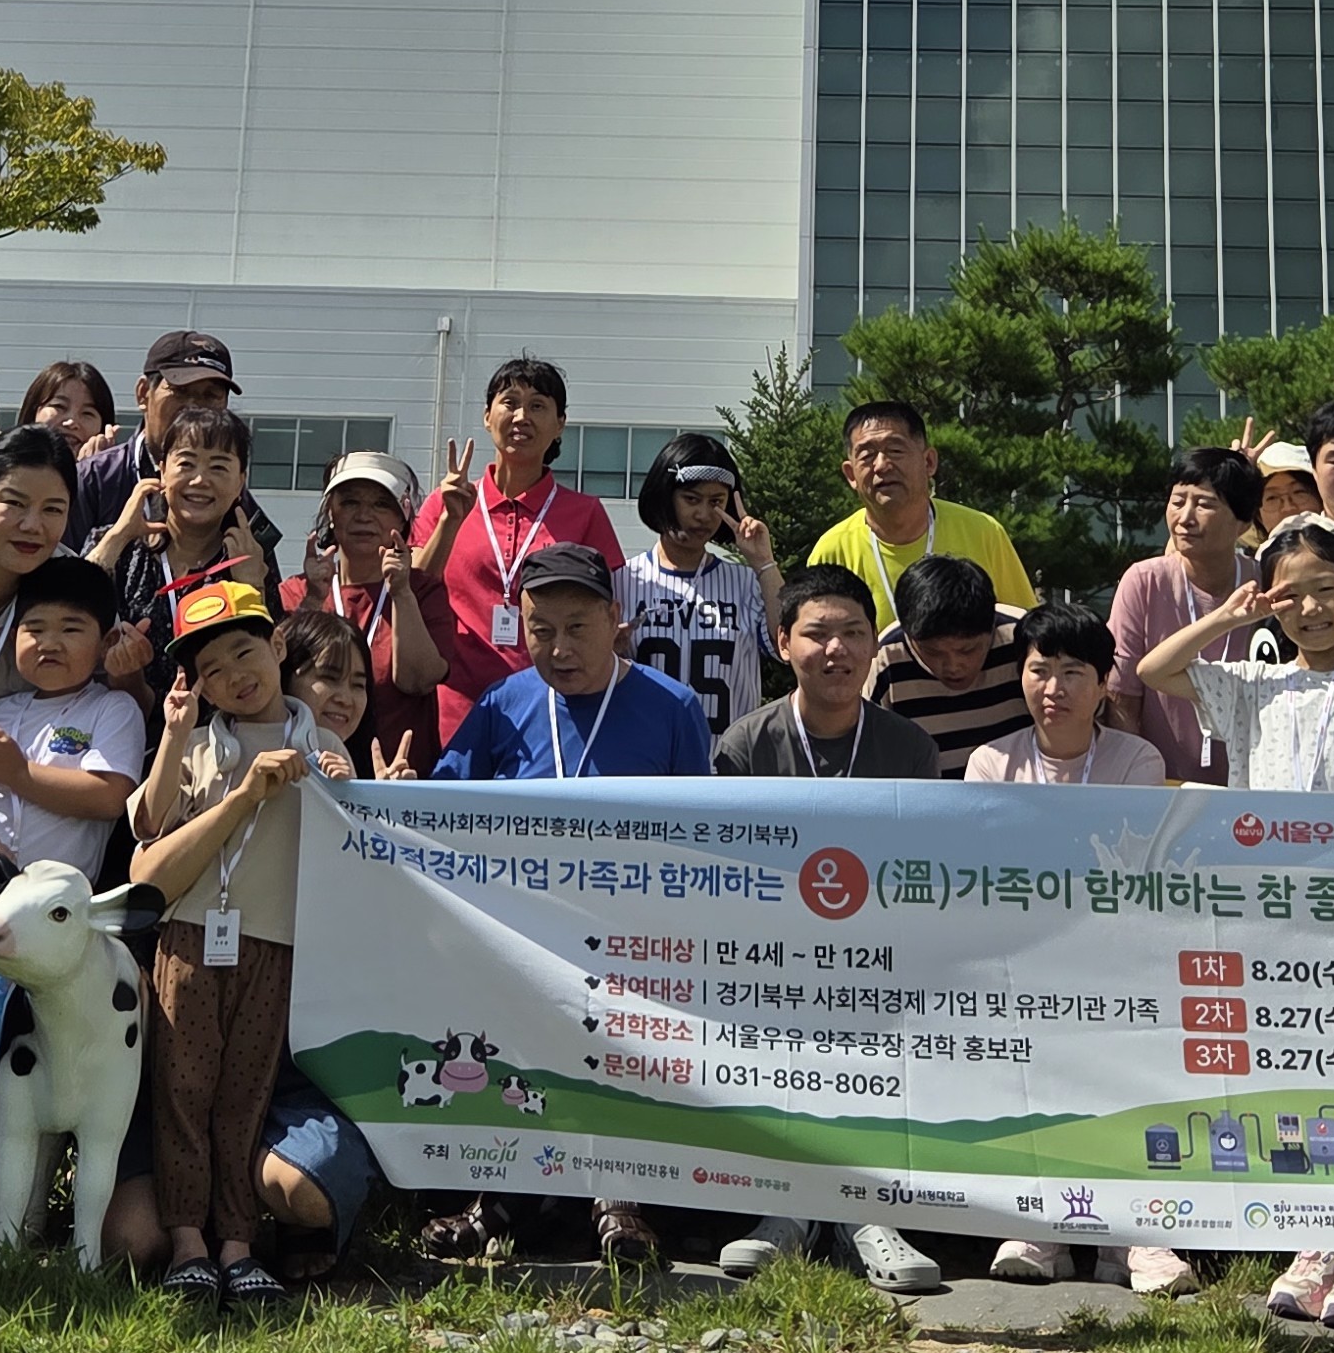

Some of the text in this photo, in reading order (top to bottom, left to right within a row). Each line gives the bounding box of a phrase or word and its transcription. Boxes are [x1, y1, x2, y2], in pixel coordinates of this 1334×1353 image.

[402, 810, 686, 843] 한국사회적기업진흥원(소셜캠퍼스
[692, 823, 710, 843] 온
[717, 824, 798, 849] 경기북부)
[341, 829, 549, 891] 사회적경제기업
[558, 859, 651, 897] 가족과
[659, 863, 785, 902] 함께하는
[1084, 868, 1246, 918] 함께하는
[1257, 873, 1296, 919] 참
[604, 935, 695, 964] 모집대상
[716, 940, 739, 966] 만
[745, 941, 784, 968] 4세
[813, 944, 836, 970] 만
[843, 945, 893, 972] 12세
[1191, 955, 1227, 982] 1차
[604, 972, 1160, 1023] 참여대상 경기북부 사회적경제 기업 및 유관기관 가족
[1195, 1001, 1234, 1028] 2차
[604, 1012, 1033, 1063] 견학장소 서울우유 양주공장 견학 홍보관
[1196, 1043, 1236, 1070] 3차
[603, 1052, 901, 1097] 문의사항 031-868-8062
[422, 1144, 449, 1160] 주최
[470, 1165, 507, 1180] 양주시
[708, 1172, 751, 1187] 서울우유
[840, 1184, 867, 1200] 주관
[1016, 1196, 1044, 1213] 협력
[1274, 1215, 1309, 1229] 양주시
